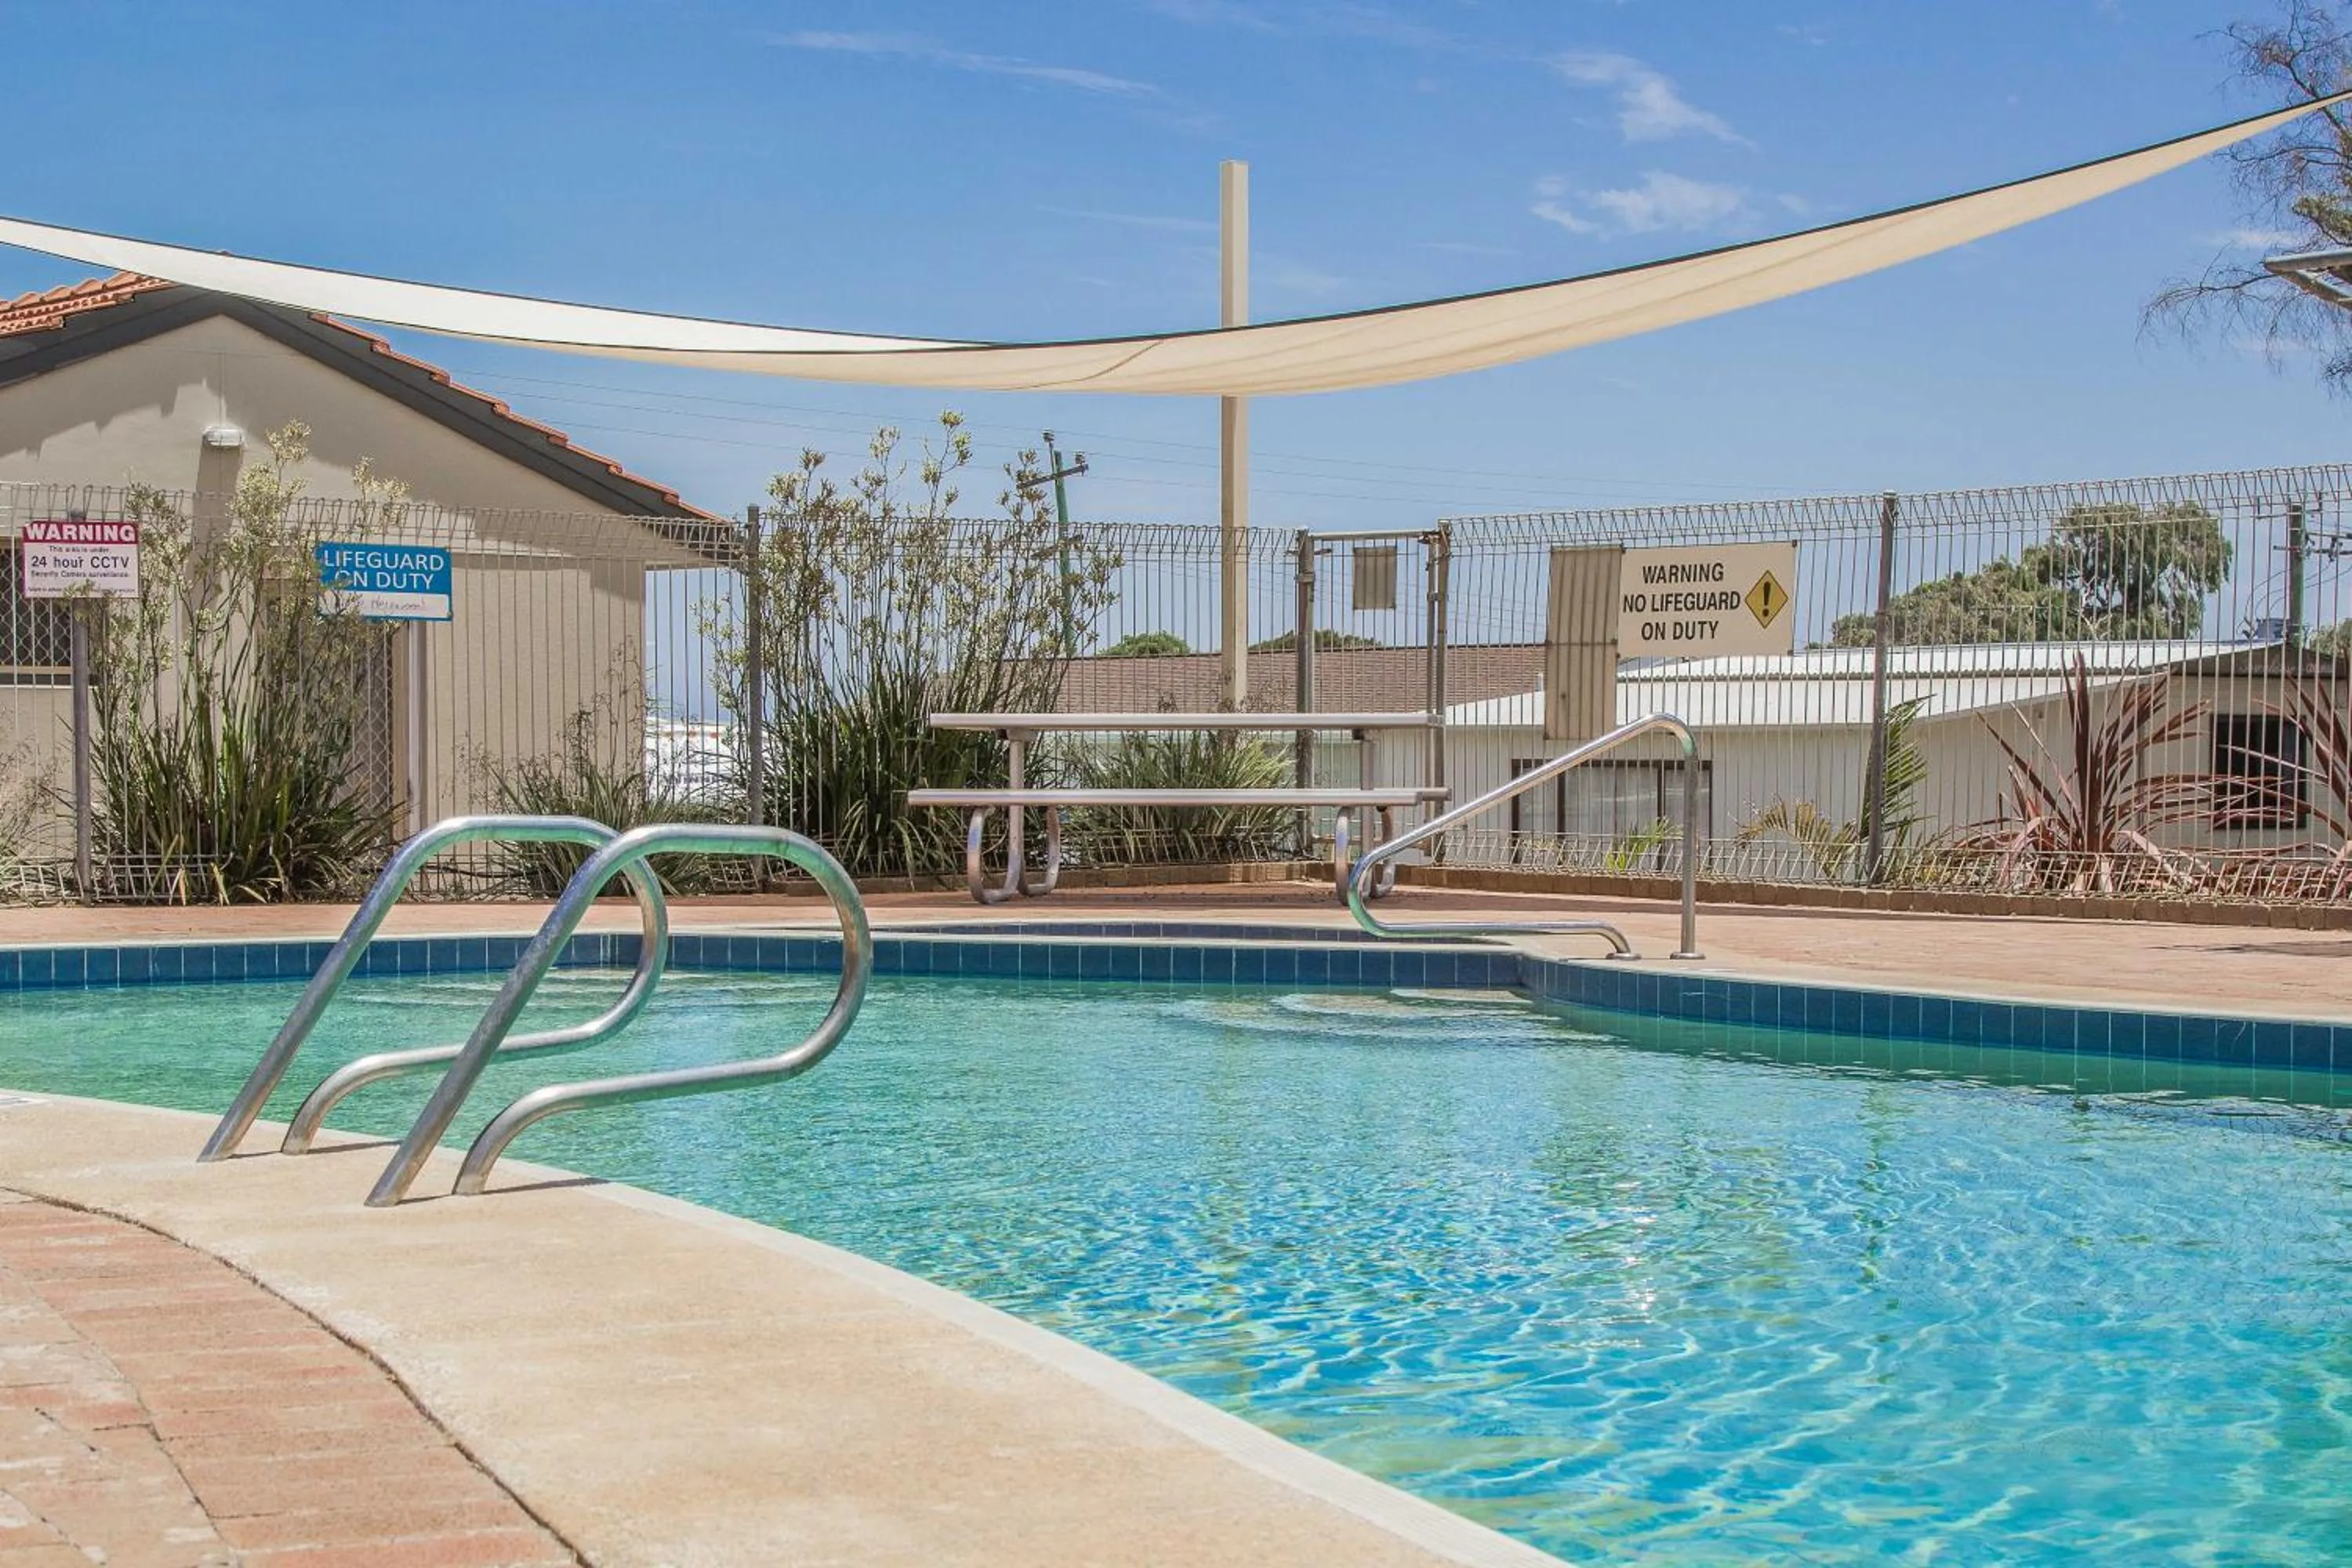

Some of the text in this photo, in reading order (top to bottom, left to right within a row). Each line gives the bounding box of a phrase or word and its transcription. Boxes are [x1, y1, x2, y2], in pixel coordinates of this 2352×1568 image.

[26, 524, 136, 541] WARNING
[31, 556, 129, 568] 24 hour CCTV
[323, 550, 445, 572] LIFEGUARD
[376, 572, 434, 590] DUTY
[1642, 562, 1724, 584] WARNING
[1623, 591, 1740, 612] NO LIFEGUARD
[1641, 621, 1719, 641] ON DUTY
